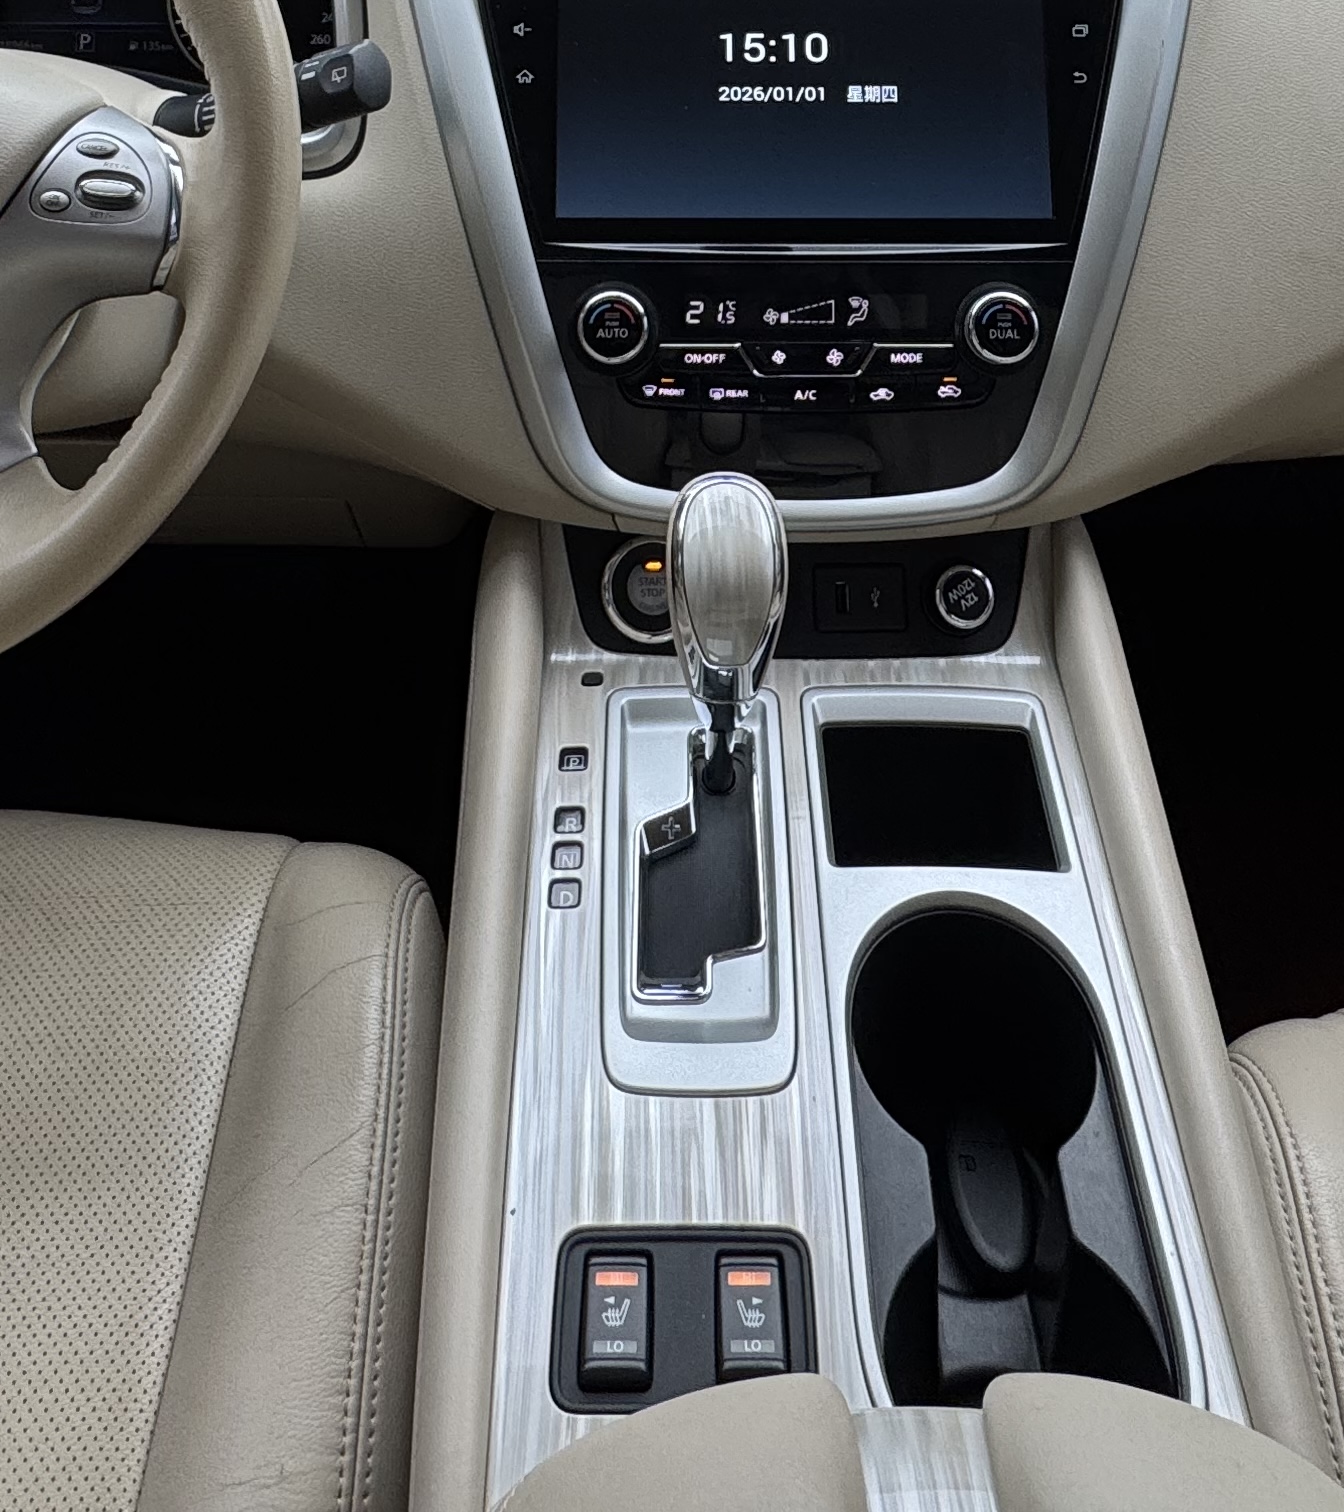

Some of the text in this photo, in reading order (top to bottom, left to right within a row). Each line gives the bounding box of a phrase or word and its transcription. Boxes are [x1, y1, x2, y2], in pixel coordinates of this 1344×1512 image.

[79, 34, 91, 50] P
[309, 33, 331, 45] 260
[718, 32, 829, 64] 15:10
[718, 84, 899, 105] 2026/01/01 星期四
[595, 327, 629, 339] AUTO
[988, 328, 1021, 340] DUAL
[890, 352, 924, 364] MODE
[658, 387, 686, 397] FRONT
[725, 388, 749, 398] REAR
[793, 388, 818, 402] A/C
[640, 588, 666, 598] STOP
[947, 577, 976, 604] 120W
[960, 592, 979, 612] 12V
[565, 817, 576, 831] R
[561, 854, 574, 867] N
[559, 890, 574, 907] D
[606, 1341, 624, 1353] LO
[743, 1340, 762, 1352] LO
